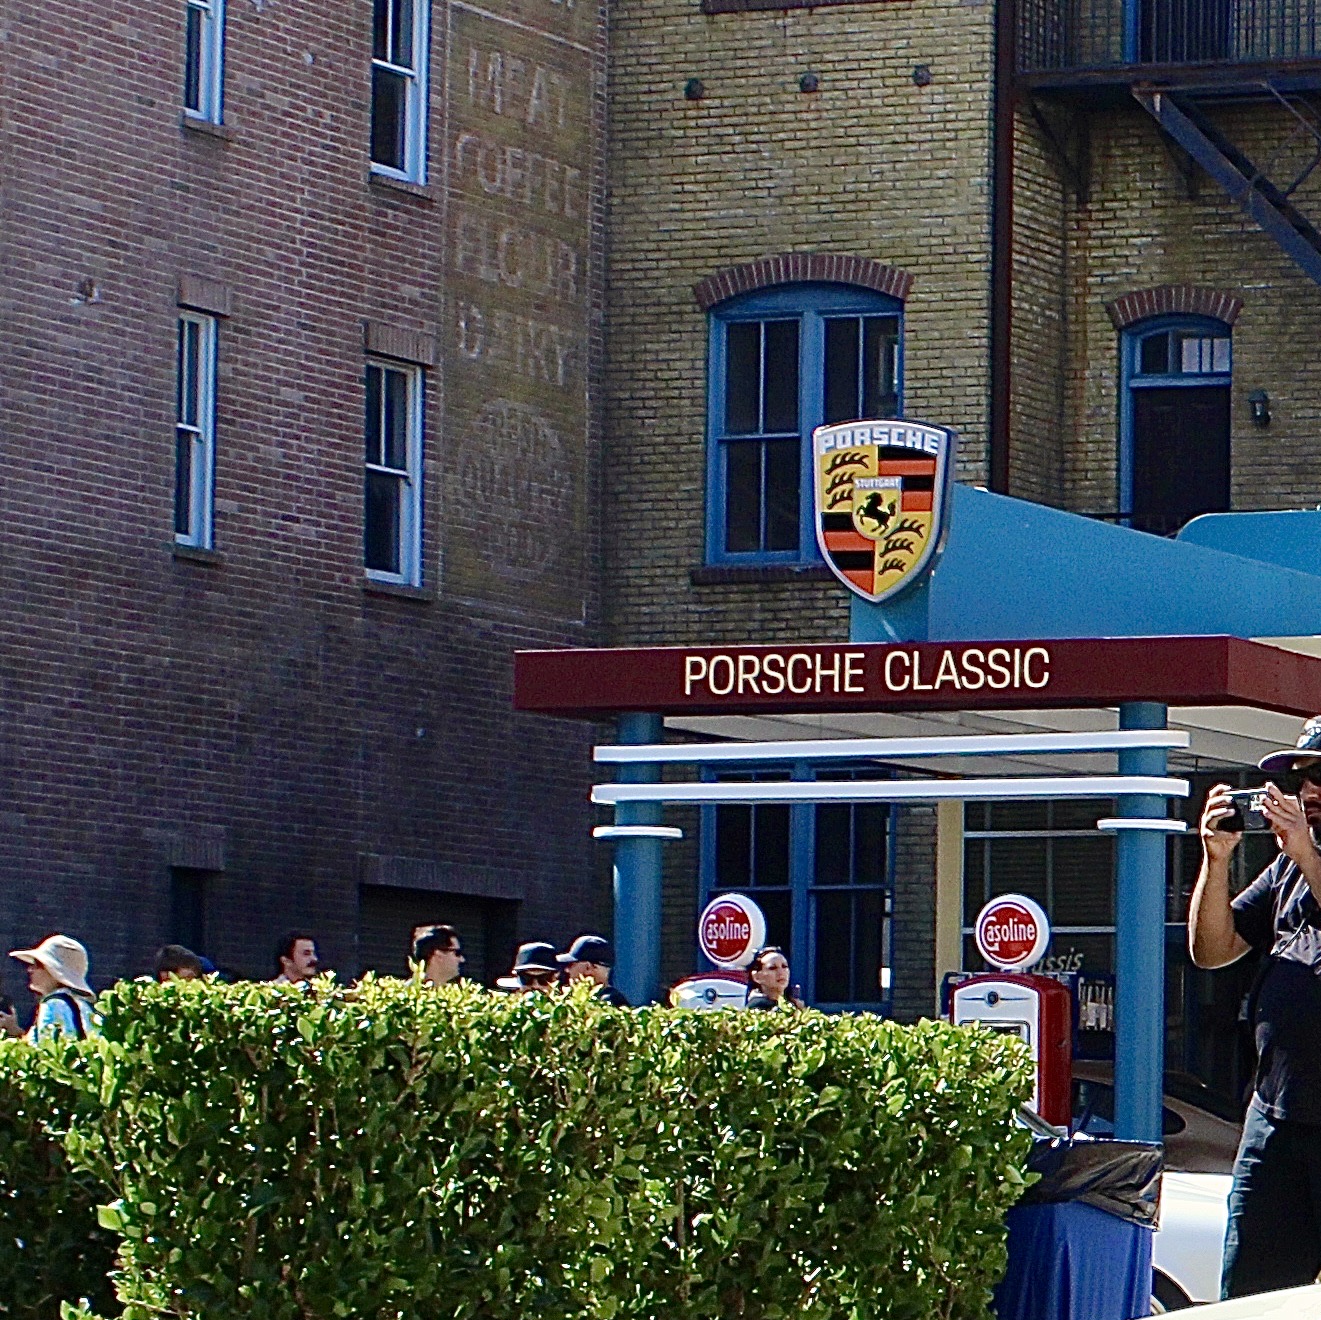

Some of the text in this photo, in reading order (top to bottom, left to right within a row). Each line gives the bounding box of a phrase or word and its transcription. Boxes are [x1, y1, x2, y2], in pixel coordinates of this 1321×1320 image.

[820, 427, 939, 455] PORSCHE
[684, 647, 1051, 696] PORSCHE CLASSIC
[704, 913, 750, 949] Gasoline
[981, 916, 1036, 951] Gasoline
